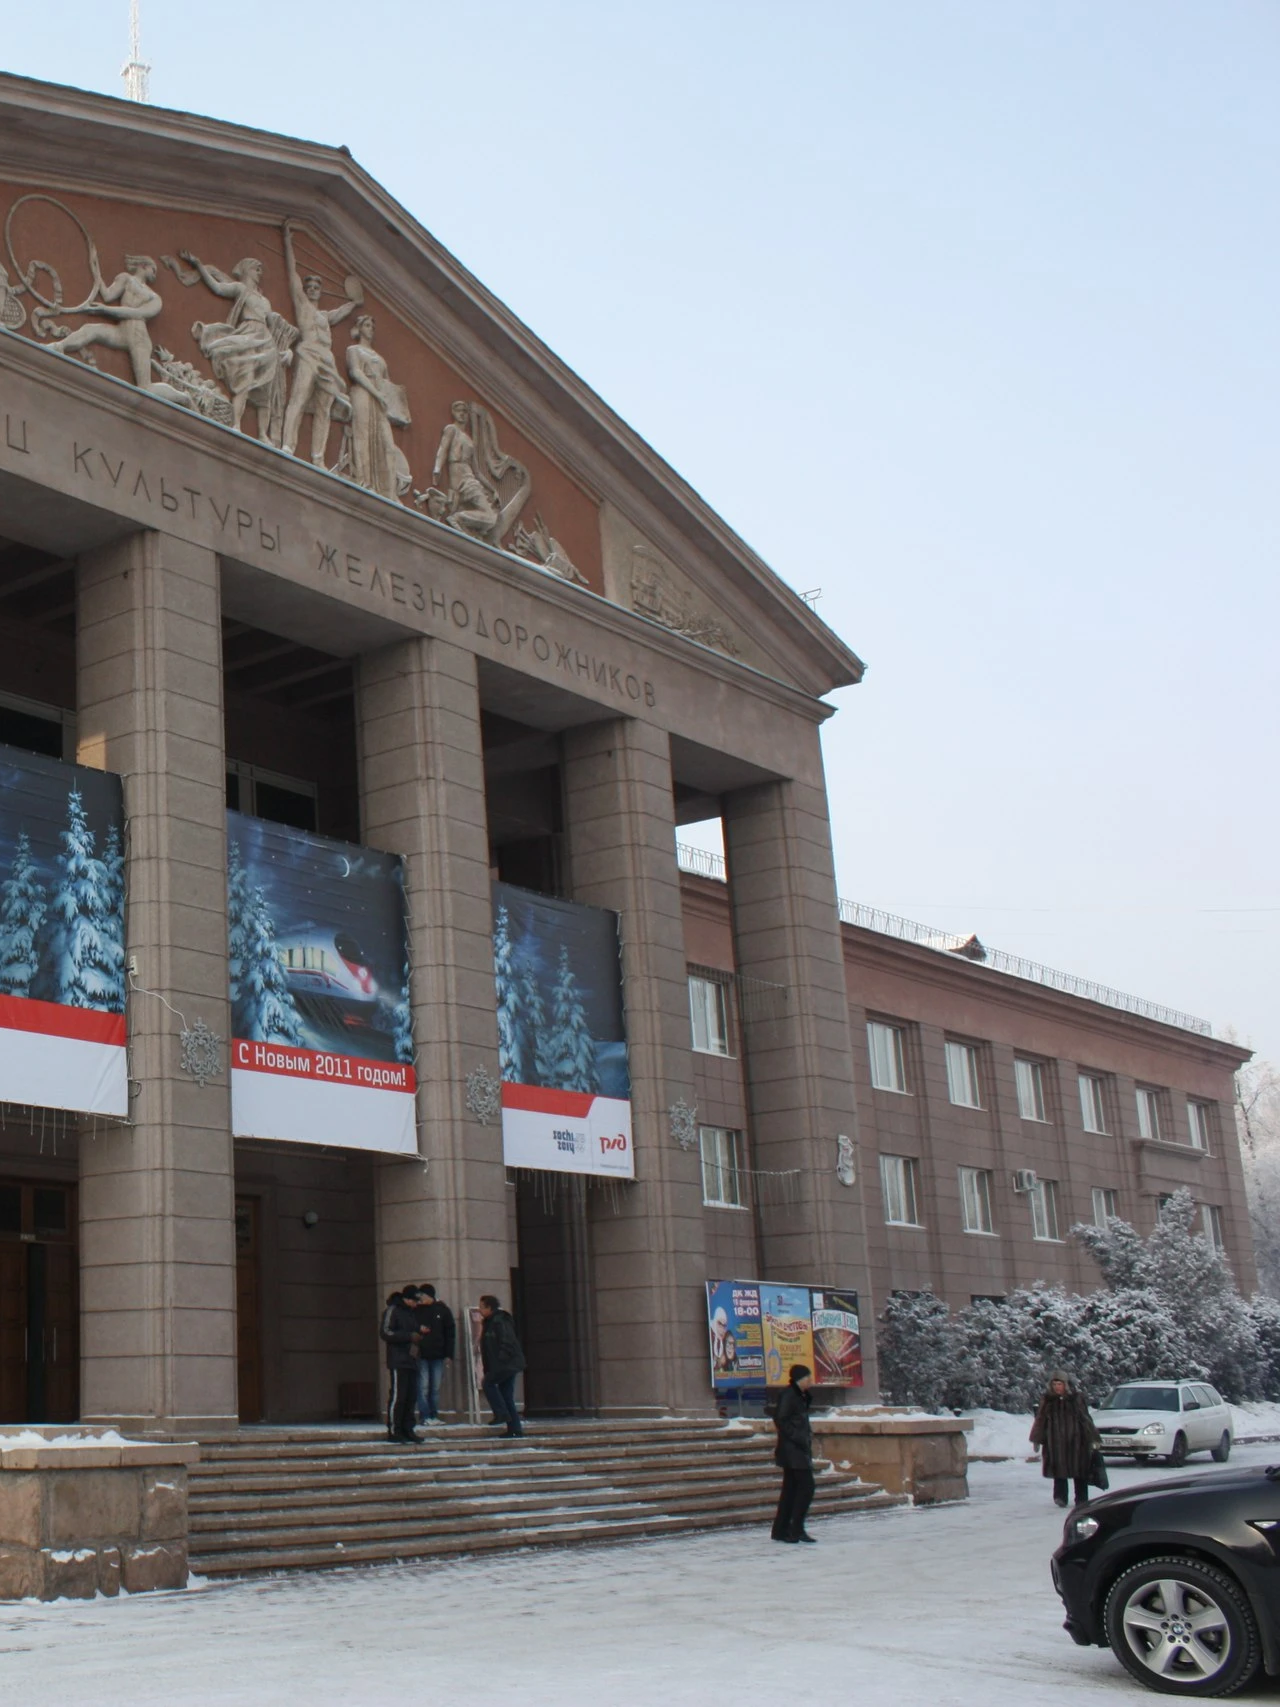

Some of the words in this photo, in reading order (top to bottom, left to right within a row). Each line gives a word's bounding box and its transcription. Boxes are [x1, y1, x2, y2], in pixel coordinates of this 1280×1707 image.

[73, 441, 282, 554] КУЛЬТУРЫ
[315, 539, 656, 708] ЖЕЛЕЗНОДОРОЖНИКОВ
[238, 1043, 249, 1064] С
[255, 1045, 310, 1072] Новым
[315, 1054, 352, 1078] 2011
[357, 1066, 407, 1086] годом!
[557, 1141, 575, 1155] 2014
[733, 1306, 759, 1316] 18-00
